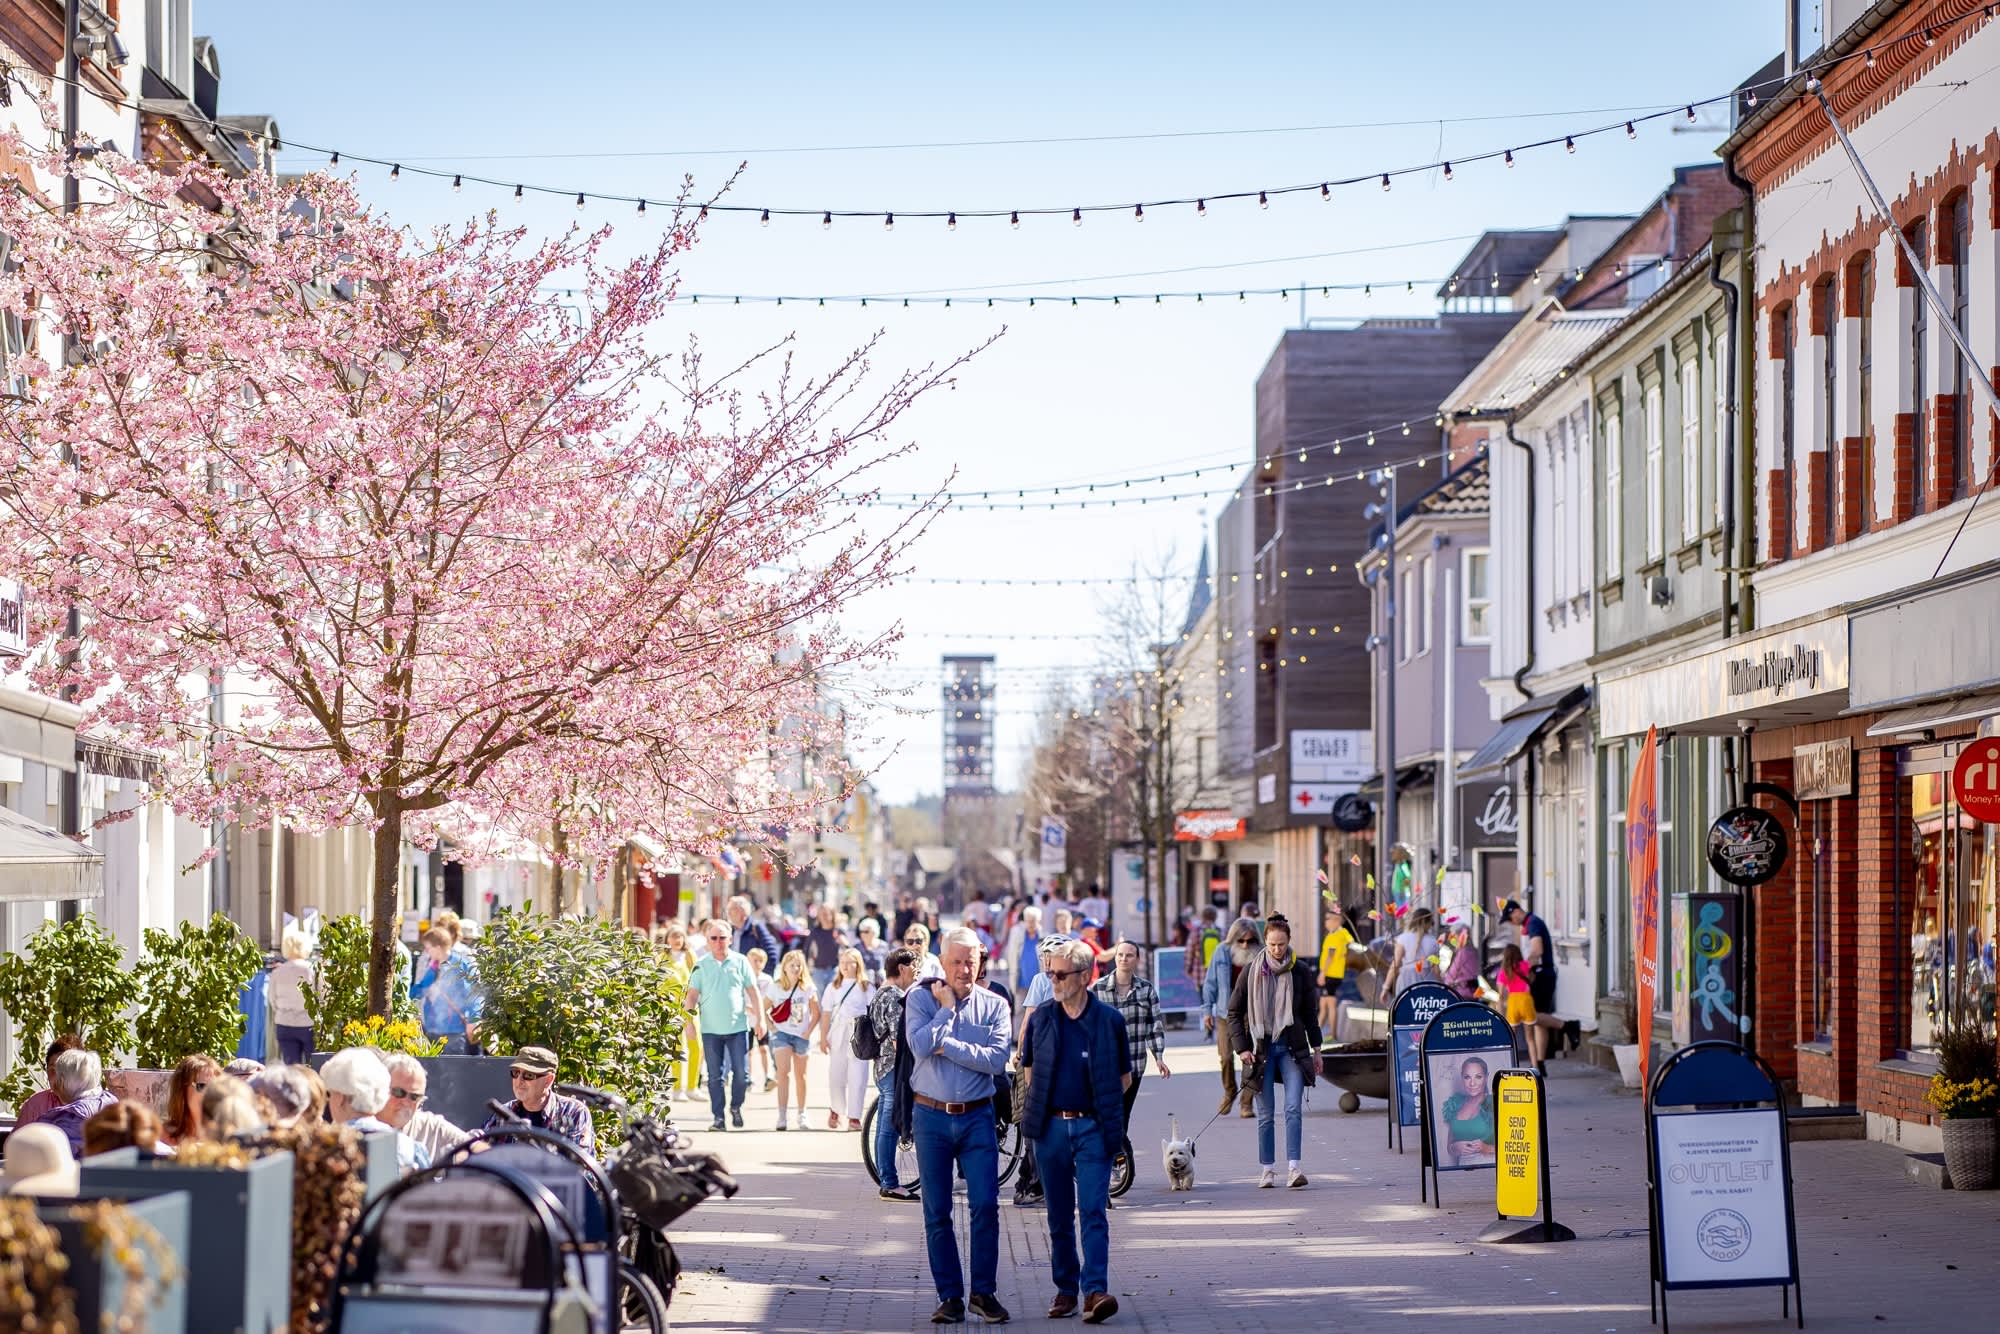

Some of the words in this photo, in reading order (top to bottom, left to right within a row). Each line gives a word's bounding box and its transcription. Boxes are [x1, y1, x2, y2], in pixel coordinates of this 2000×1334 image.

[1964, 794, 1993, 804] Money
[1410, 997, 1448, 1009] Viking
[1449, 1019, 1492, 1031] Gullsmed
[1443, 1029, 1470, 1039] Kyrre
[1471, 1028, 1493, 1037] Berg
[1508, 1116, 1526, 1128] SEND
[1510, 1129, 1525, 1140] AND
[1504, 1141, 1530, 1153] RECEIVE
[1505, 1154, 1529, 1165] MONEY
[1508, 1166, 1526, 1178] HERE
[1668, 1160, 1774, 1184] OUTLET
